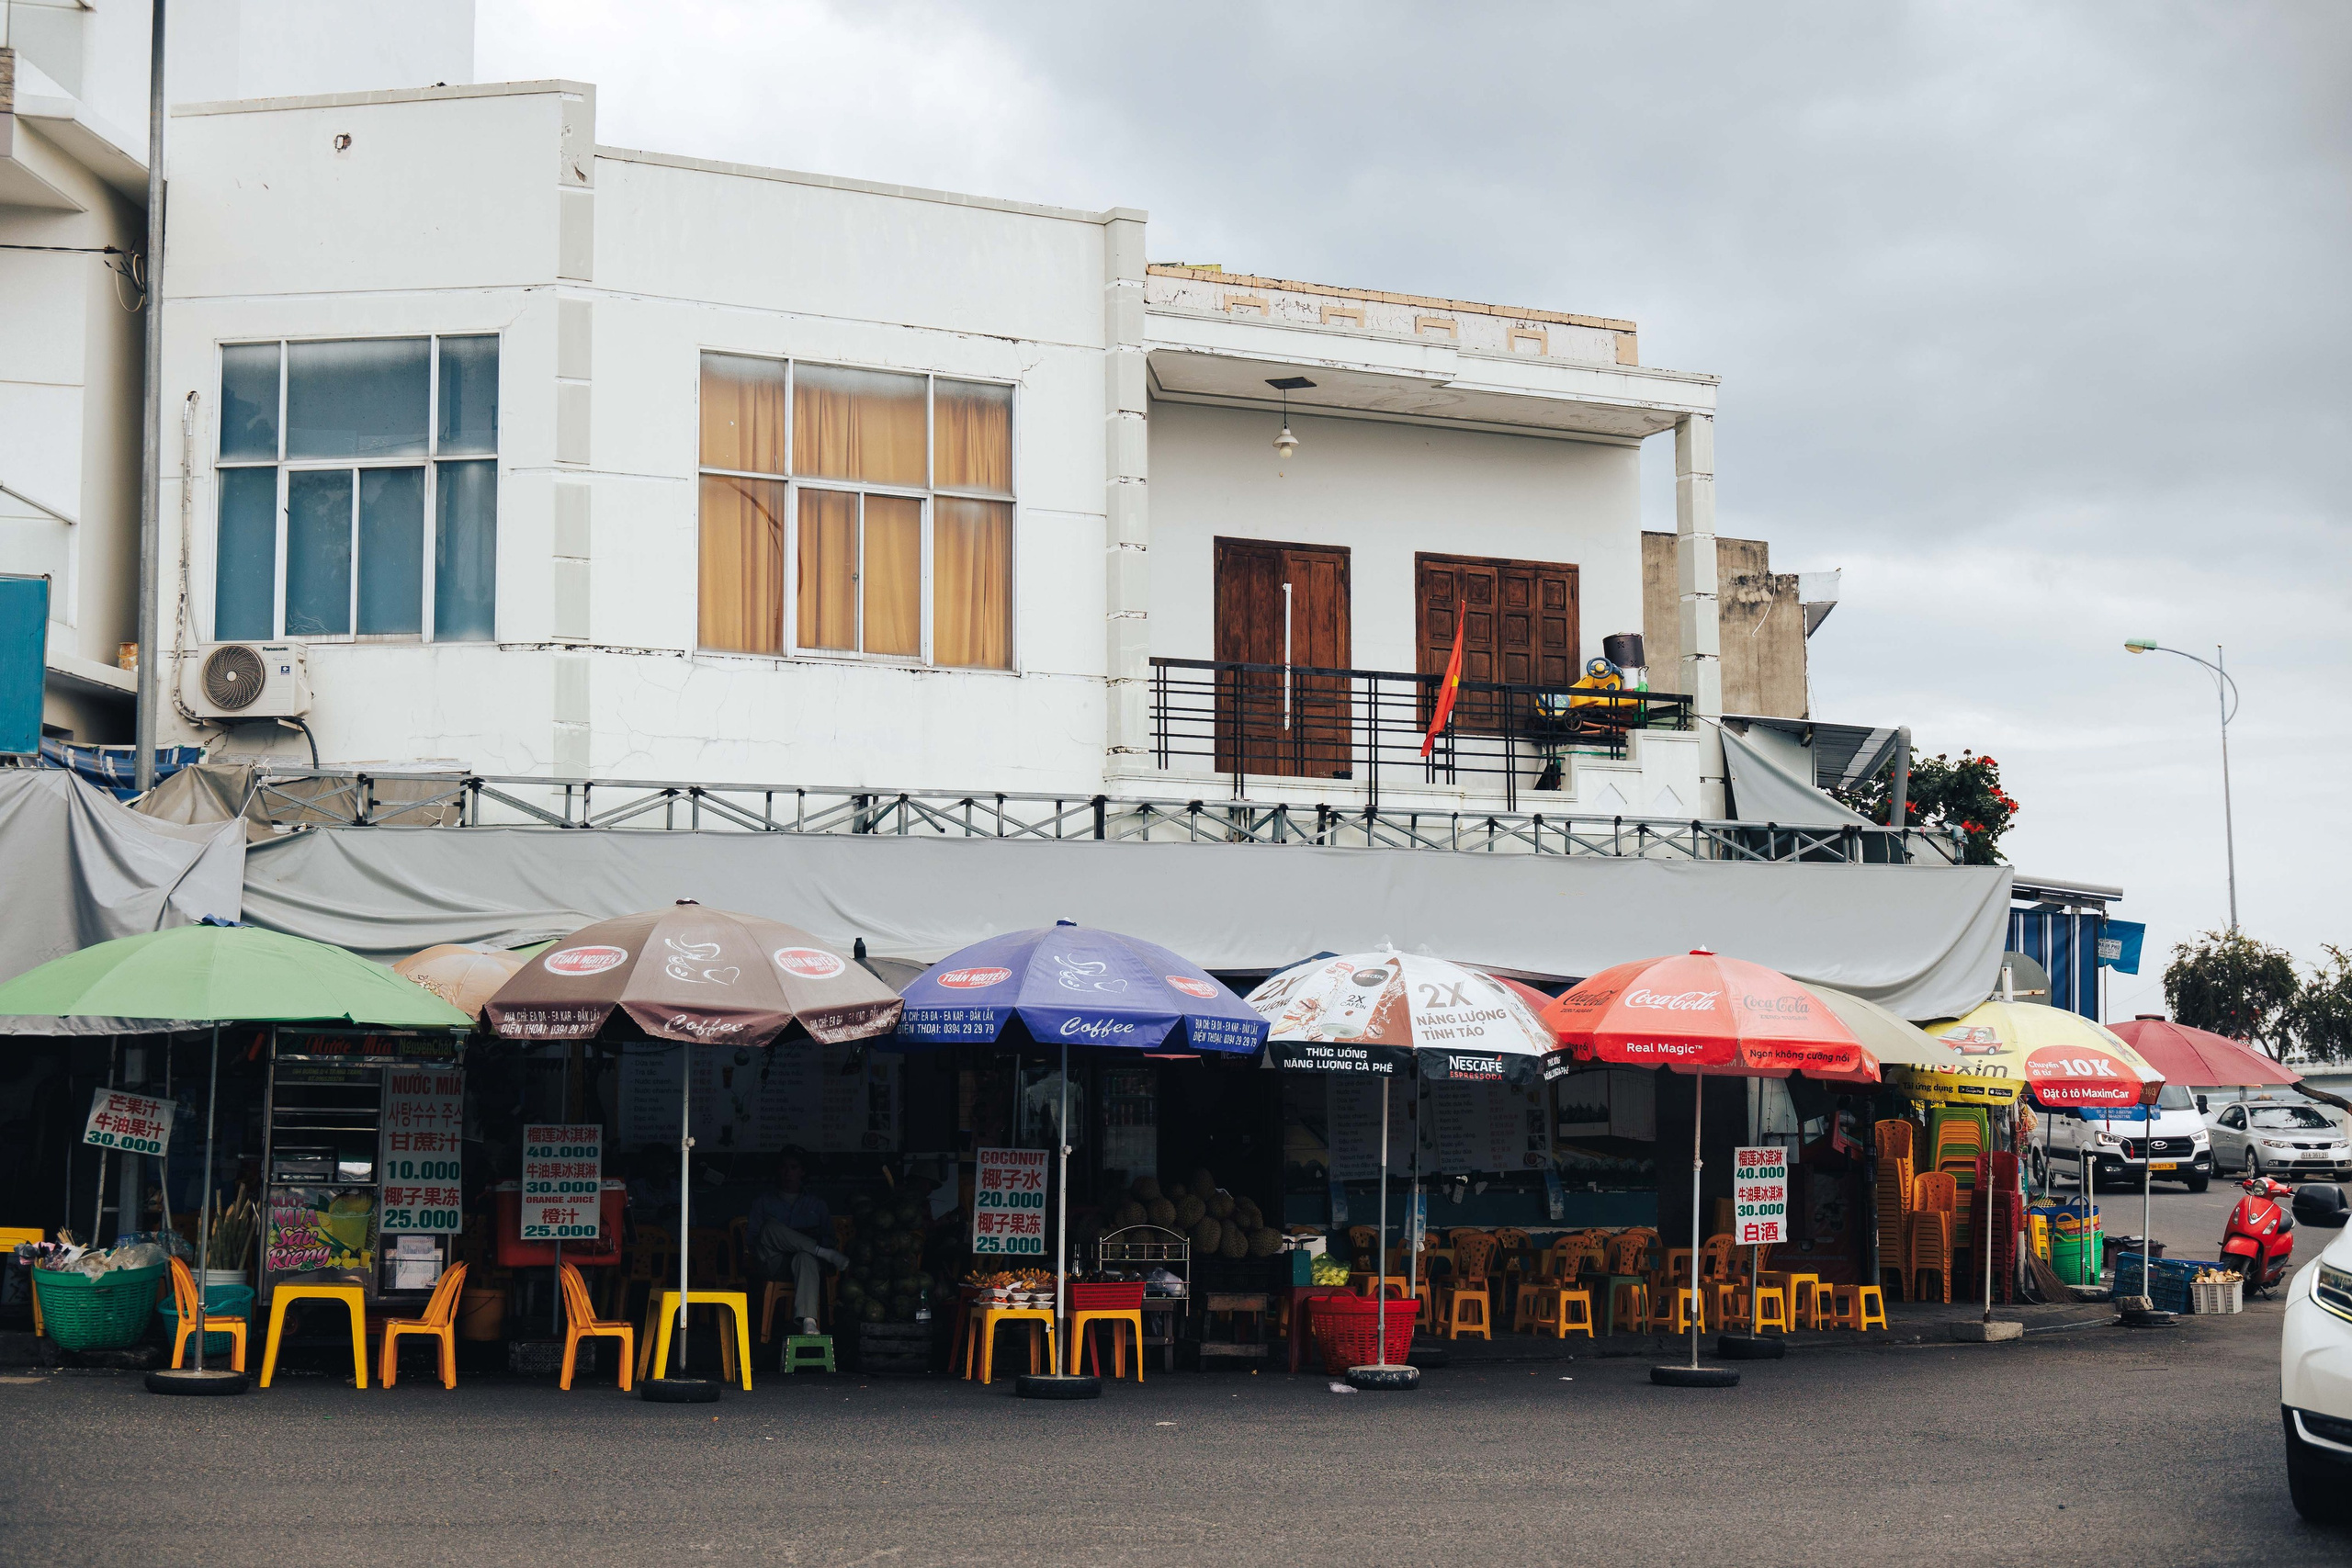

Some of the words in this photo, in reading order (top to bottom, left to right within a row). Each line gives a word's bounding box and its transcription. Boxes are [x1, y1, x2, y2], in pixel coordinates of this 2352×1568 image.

[943, 970, 968, 983] TUẤN
[968, 968, 1010, 982] NGUYÊN
[1250, 974, 1309, 1002] 2X
[1418, 978, 1474, 1009] 2X
[1347, 994, 1366, 1003] 2X
[1624, 988, 1724, 1011] Coca-Cola
[1743, 994, 1810, 1014] Coca-Cola
[529, 1011, 537, 1021] EA
[922, 1011, 930, 1021] EA
[944, 1011, 952, 1021] EA
[953, 1011, 964, 1021] KAR
[969, 1007, 981, 1021] ĐẮK
[982, 1007, 994, 1021] LẮK
[1416, 1011, 1460, 1026] NĂNG
[1458, 1008, 1507, 1024] LƯỢNG
[663, 1014, 744, 1038] Coffee
[917, 1023, 942, 1037] THOẠI:
[944, 1023, 960, 1034] 0394
[963, 1023, 972, 1034] 29
[974, 1023, 983, 1034] 29
[985, 1023, 995, 1034] 79
[1059, 1016, 1135, 1038] Coffee
[1421, 1026, 1456, 1042] TỈNH
[1457, 1022, 1486, 1038] TẢO
[1224, 1033, 1235, 1044] 0394
[1236, 1035, 1242, 1045] 29
[1243, 1036, 1250, 1046] 29
[1250, 1037, 1257, 1047] 79
[1626, 1042, 1655, 1053] Real
[1306, 1045, 1335, 1057] THỨC
[1338, 1046, 1367, 1059] UỐNG
[1749, 1050, 1773, 1059] Ngon
[1775, 1051, 1804, 1060] không
[1806, 1053, 1834, 1062] cưỡng
[1835, 1052, 1850, 1063] nổi
[1283, 1058, 1313, 1070] NĂNG
[1317, 1059, 1353, 1072] LƯỢNG
[1355, 1059, 1371, 1071] CÀ
[1372, 1060, 1394, 1073] PHÊ
[1449, 1055, 1504, 1074] NESCAFÉ
[2028, 1060, 2060, 1070] Chuyến
[2032, 1068, 2041, 1077] đi
[2041, 1068, 2052, 1077] từ
[2059, 1058, 2118, 1077] 10K
[392, 1072, 431, 1095] NƯỚC
[435, 1072, 461, 1096] MÍA
[1450, 1071, 1503, 1081] ESPRESSODA
[1916, 1082, 1931, 1091] ứng
[1933, 1084, 1953, 1093] dụng
[2042, 1088, 2060, 1100] Đặt
[2062, 1089, 2068, 1098] ô
[2069, 1089, 2080, 1099] tô
[2082, 1089, 2130, 1100] MaximCar
[109, 1093, 161, 1118] 芒果汁
[389, 1101, 436, 1127] 사탕수수
[96, 1111, 164, 1139] 牛油果汁
[87, 1130, 161, 1154] 30.000
[389, 1132, 460, 1152] 甘蔗汁
[527, 1127, 598, 1143] 榴莲冰淇淋
[526, 1146, 598, 1157] 40.000
[980, 1151, 1046, 1166] COCONUT
[387, 1160, 459, 1180] 10.000
[526, 1162, 597, 1179] 牛油果冰淇淋
[1736, 1167, 1785, 1179] 40.000
[526, 1181, 597, 1193] 30.000
[981, 1168, 1042, 1190] 椰子水
[384, 1186, 460, 1206] 椰子果冻
[978, 1190, 1044, 1209] 20.000
[1738, 1185, 1783, 1202] 牛油果冰淇淋
[542, 1208, 580, 1224] 橙汁
[1737, 1203, 1784, 1216] 30.000
[384, 1209, 458, 1229] 25.000
[978, 1212, 1041, 1235] 椰子果冻
[275, 1224, 319, 1247] Sầu
[525, 1225, 596, 1236] 25.000
[1744, 1222, 1779, 1242] 白酒
[976, 1236, 1041, 1253] 25.000
[267, 1246, 332, 1271] Riêng
